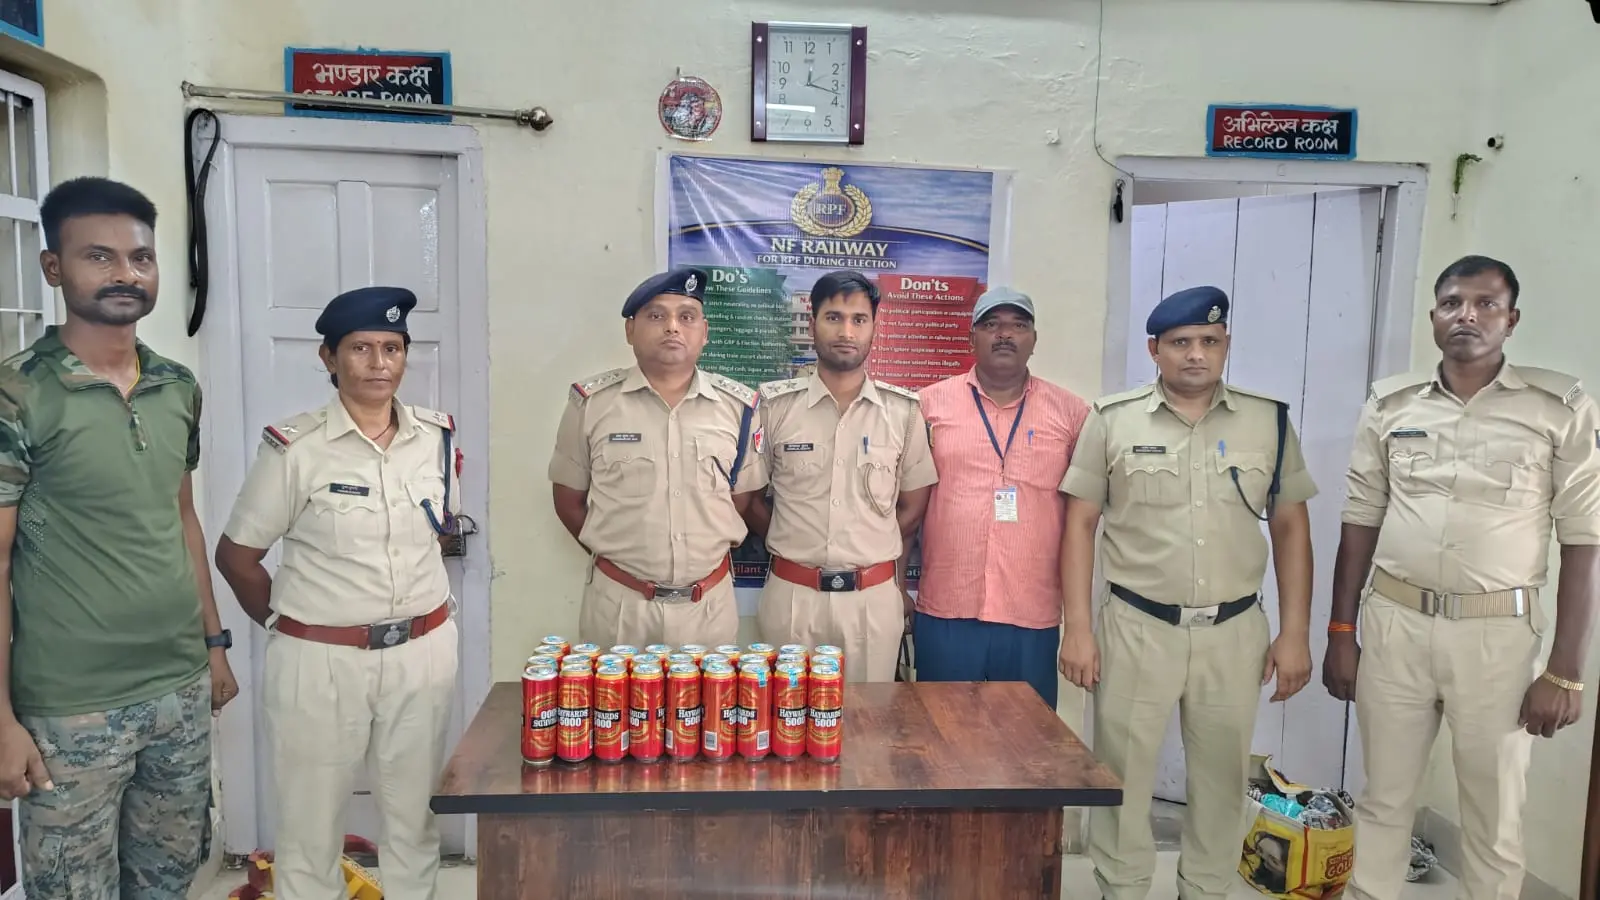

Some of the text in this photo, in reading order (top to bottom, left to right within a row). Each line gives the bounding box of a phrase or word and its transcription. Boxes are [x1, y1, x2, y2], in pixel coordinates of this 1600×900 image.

[784, 41, 793, 53] 11
[804, 41, 816, 55] 12
[827, 42, 832, 56] 1
[778, 61, 791, 74] 10
[832, 63, 840, 75] 2
[312, 63, 433, 93] भण्डार कक्ष
[779, 77, 787, 89] 9
[831, 79, 839, 91] 3
[778, 93, 786, 104] 8
[831, 96, 839, 107] 4
[784, 113, 792, 126] 7
[804, 115, 812, 127] 6
[823, 115, 832, 128] 5
[1222, 110, 1340, 138] अभिलेख कक्ष
[1223, 135, 1339, 151] RECORD ROOM
[816, 203, 847, 216] RPF
[771, 237, 888, 257] NF RAILWAY
[757, 254, 897, 269] FOR RPF DURING ELECTION
[712, 268, 749, 284] Do's
[716, 284, 736, 292] These
[737, 285, 772, 295] Guidelines
[900, 277, 949, 292] Don'ts
[887, 291, 964, 302] Avoid These Actions
[559, 717, 582, 727] 5000
[814, 718, 837, 728] 5000
